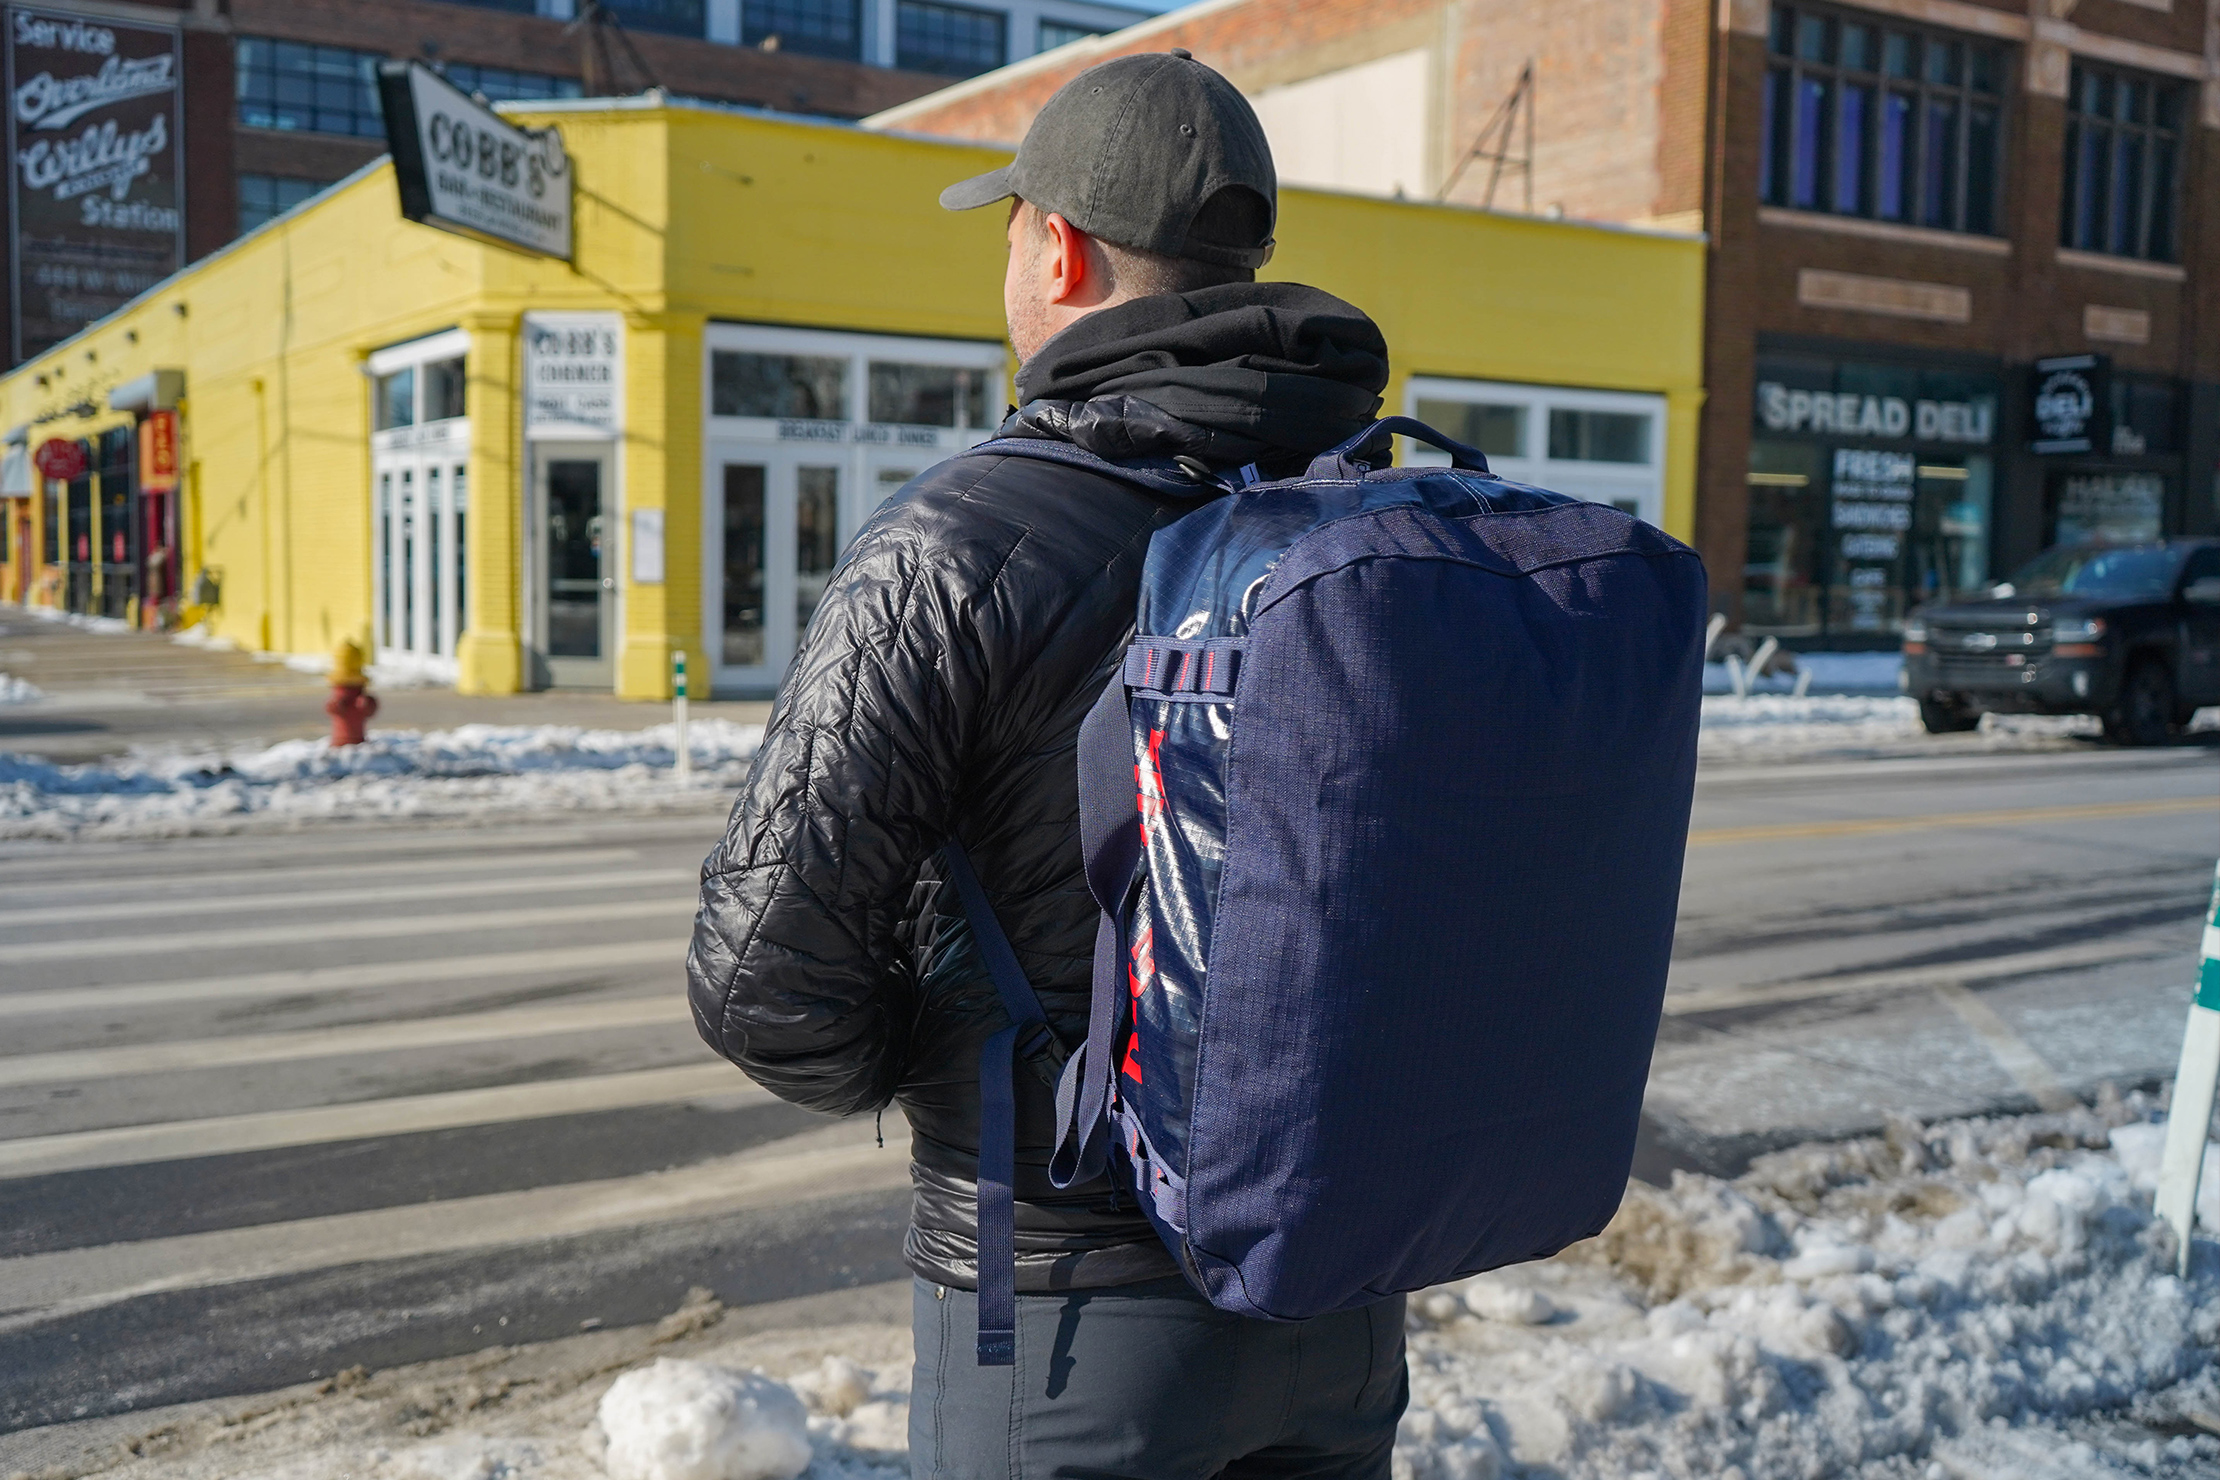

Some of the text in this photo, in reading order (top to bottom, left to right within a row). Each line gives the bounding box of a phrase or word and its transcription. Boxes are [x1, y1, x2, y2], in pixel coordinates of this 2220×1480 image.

[15, 11, 117, 54] Service
[15, 53, 177, 130] Overland
[18, 113, 167, 200] Willys
[429, 110, 546, 199] COBB'S
[80, 194, 180, 231] Station
[1758, 382, 1993, 445] SPREAD DELI
[1833, 449, 1915, 484] FRESH
